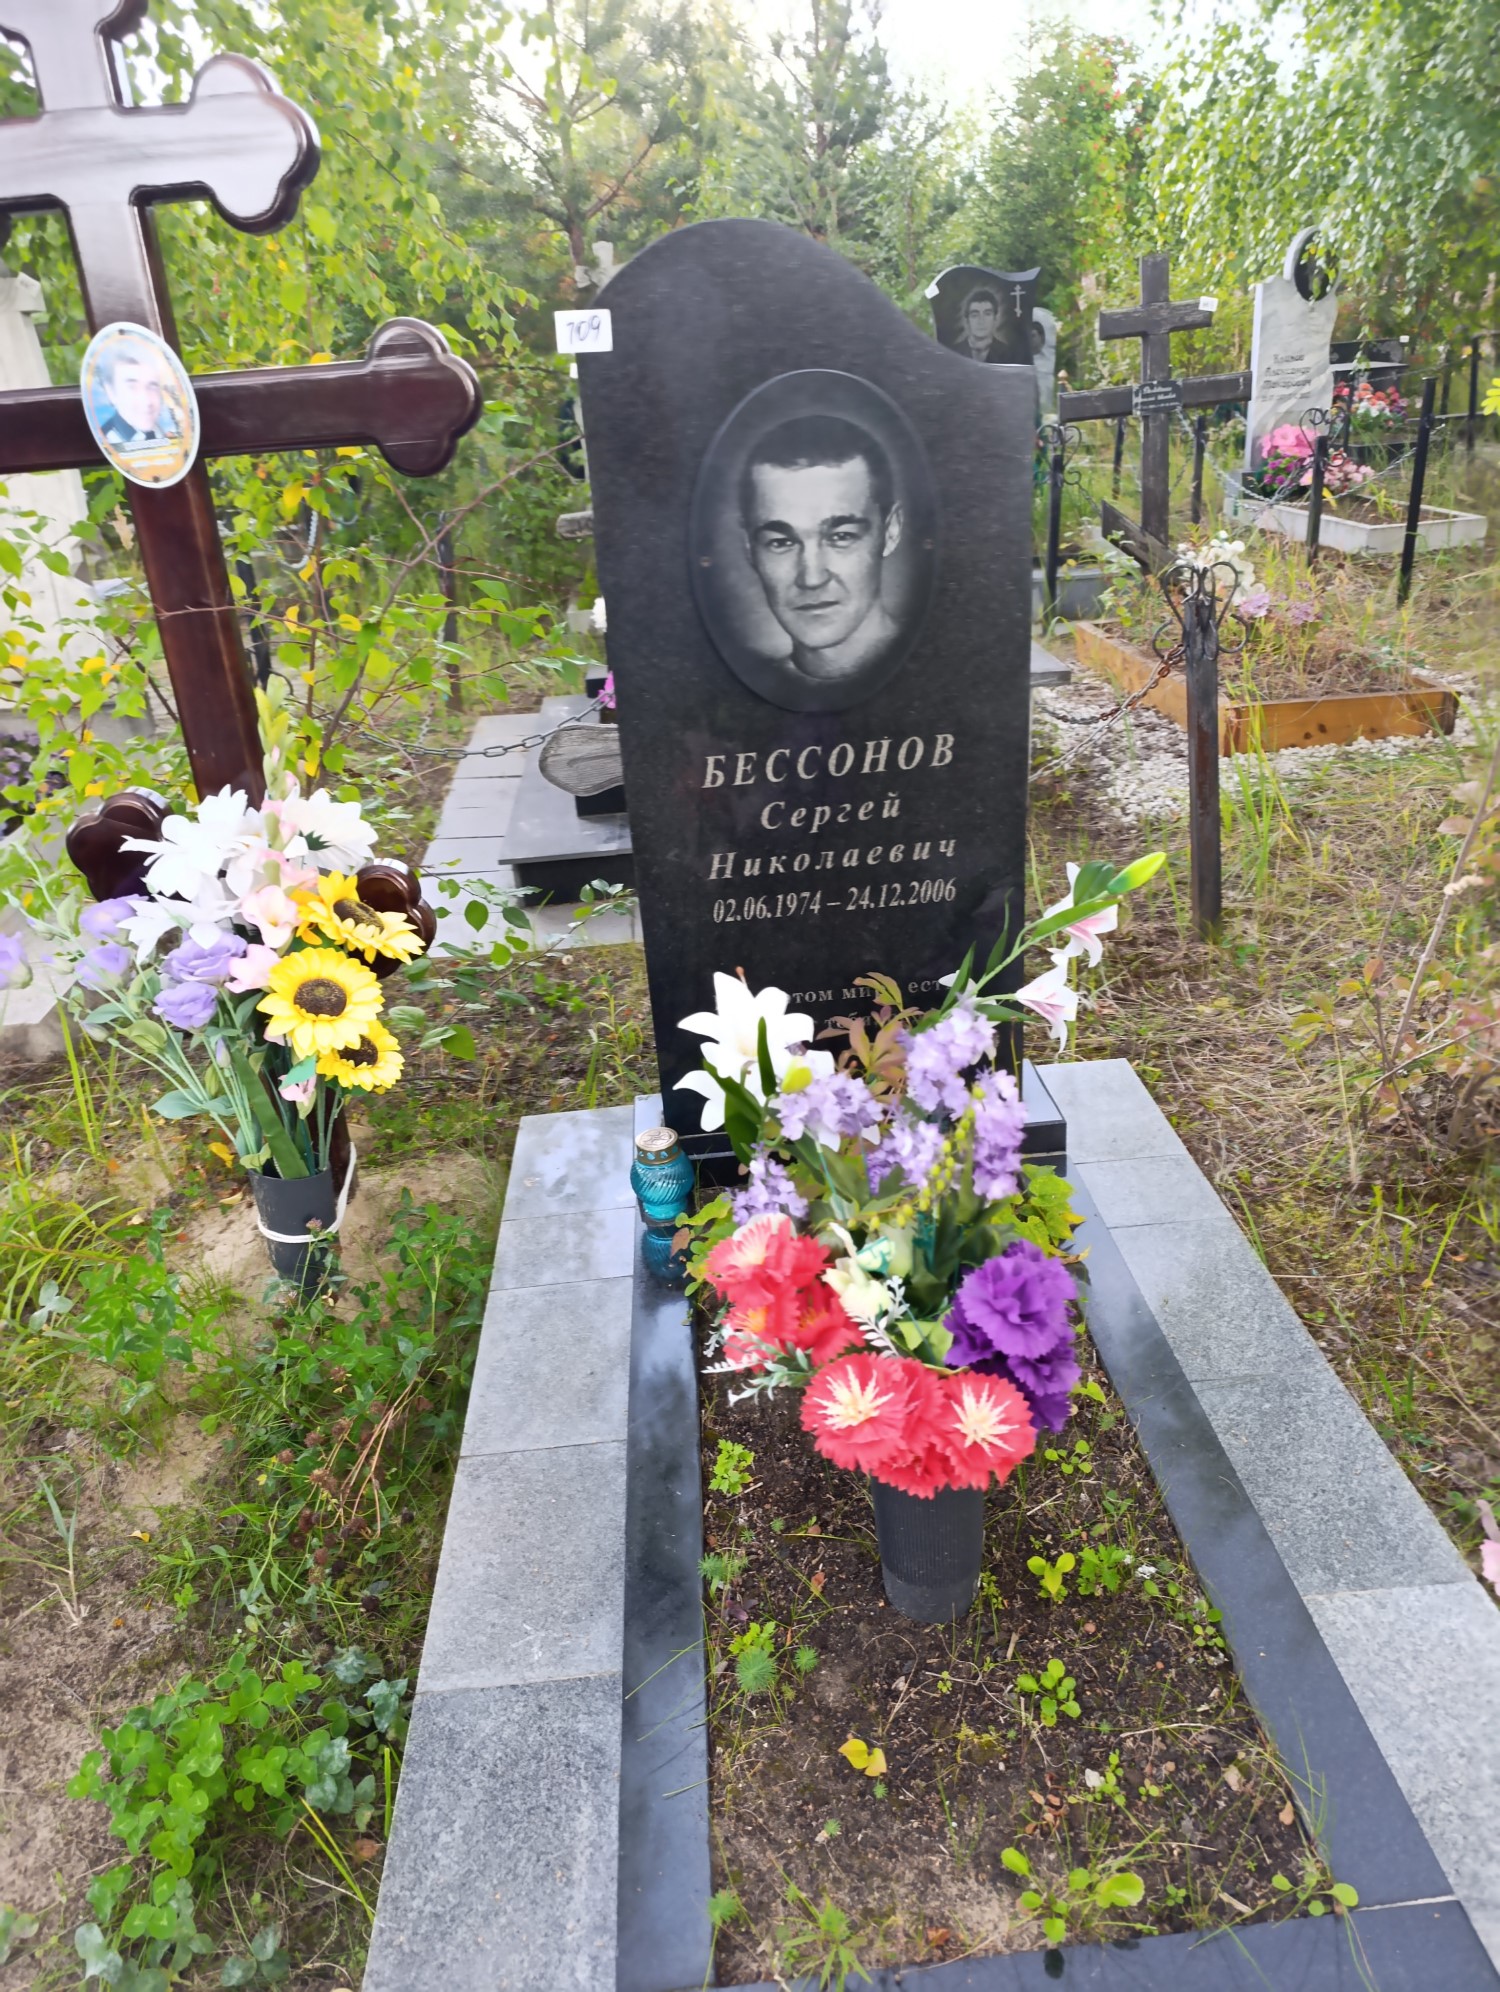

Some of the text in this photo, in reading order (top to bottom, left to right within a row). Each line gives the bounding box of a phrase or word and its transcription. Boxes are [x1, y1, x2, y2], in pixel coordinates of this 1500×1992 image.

[701, 734, 956, 789] БЕССОНОВ
[760, 791, 902, 834] Сергей
[707, 838, 957, 880] Николаевич
[789, 990, 833, 1004] том
[908, 980, 953, 996] ест
